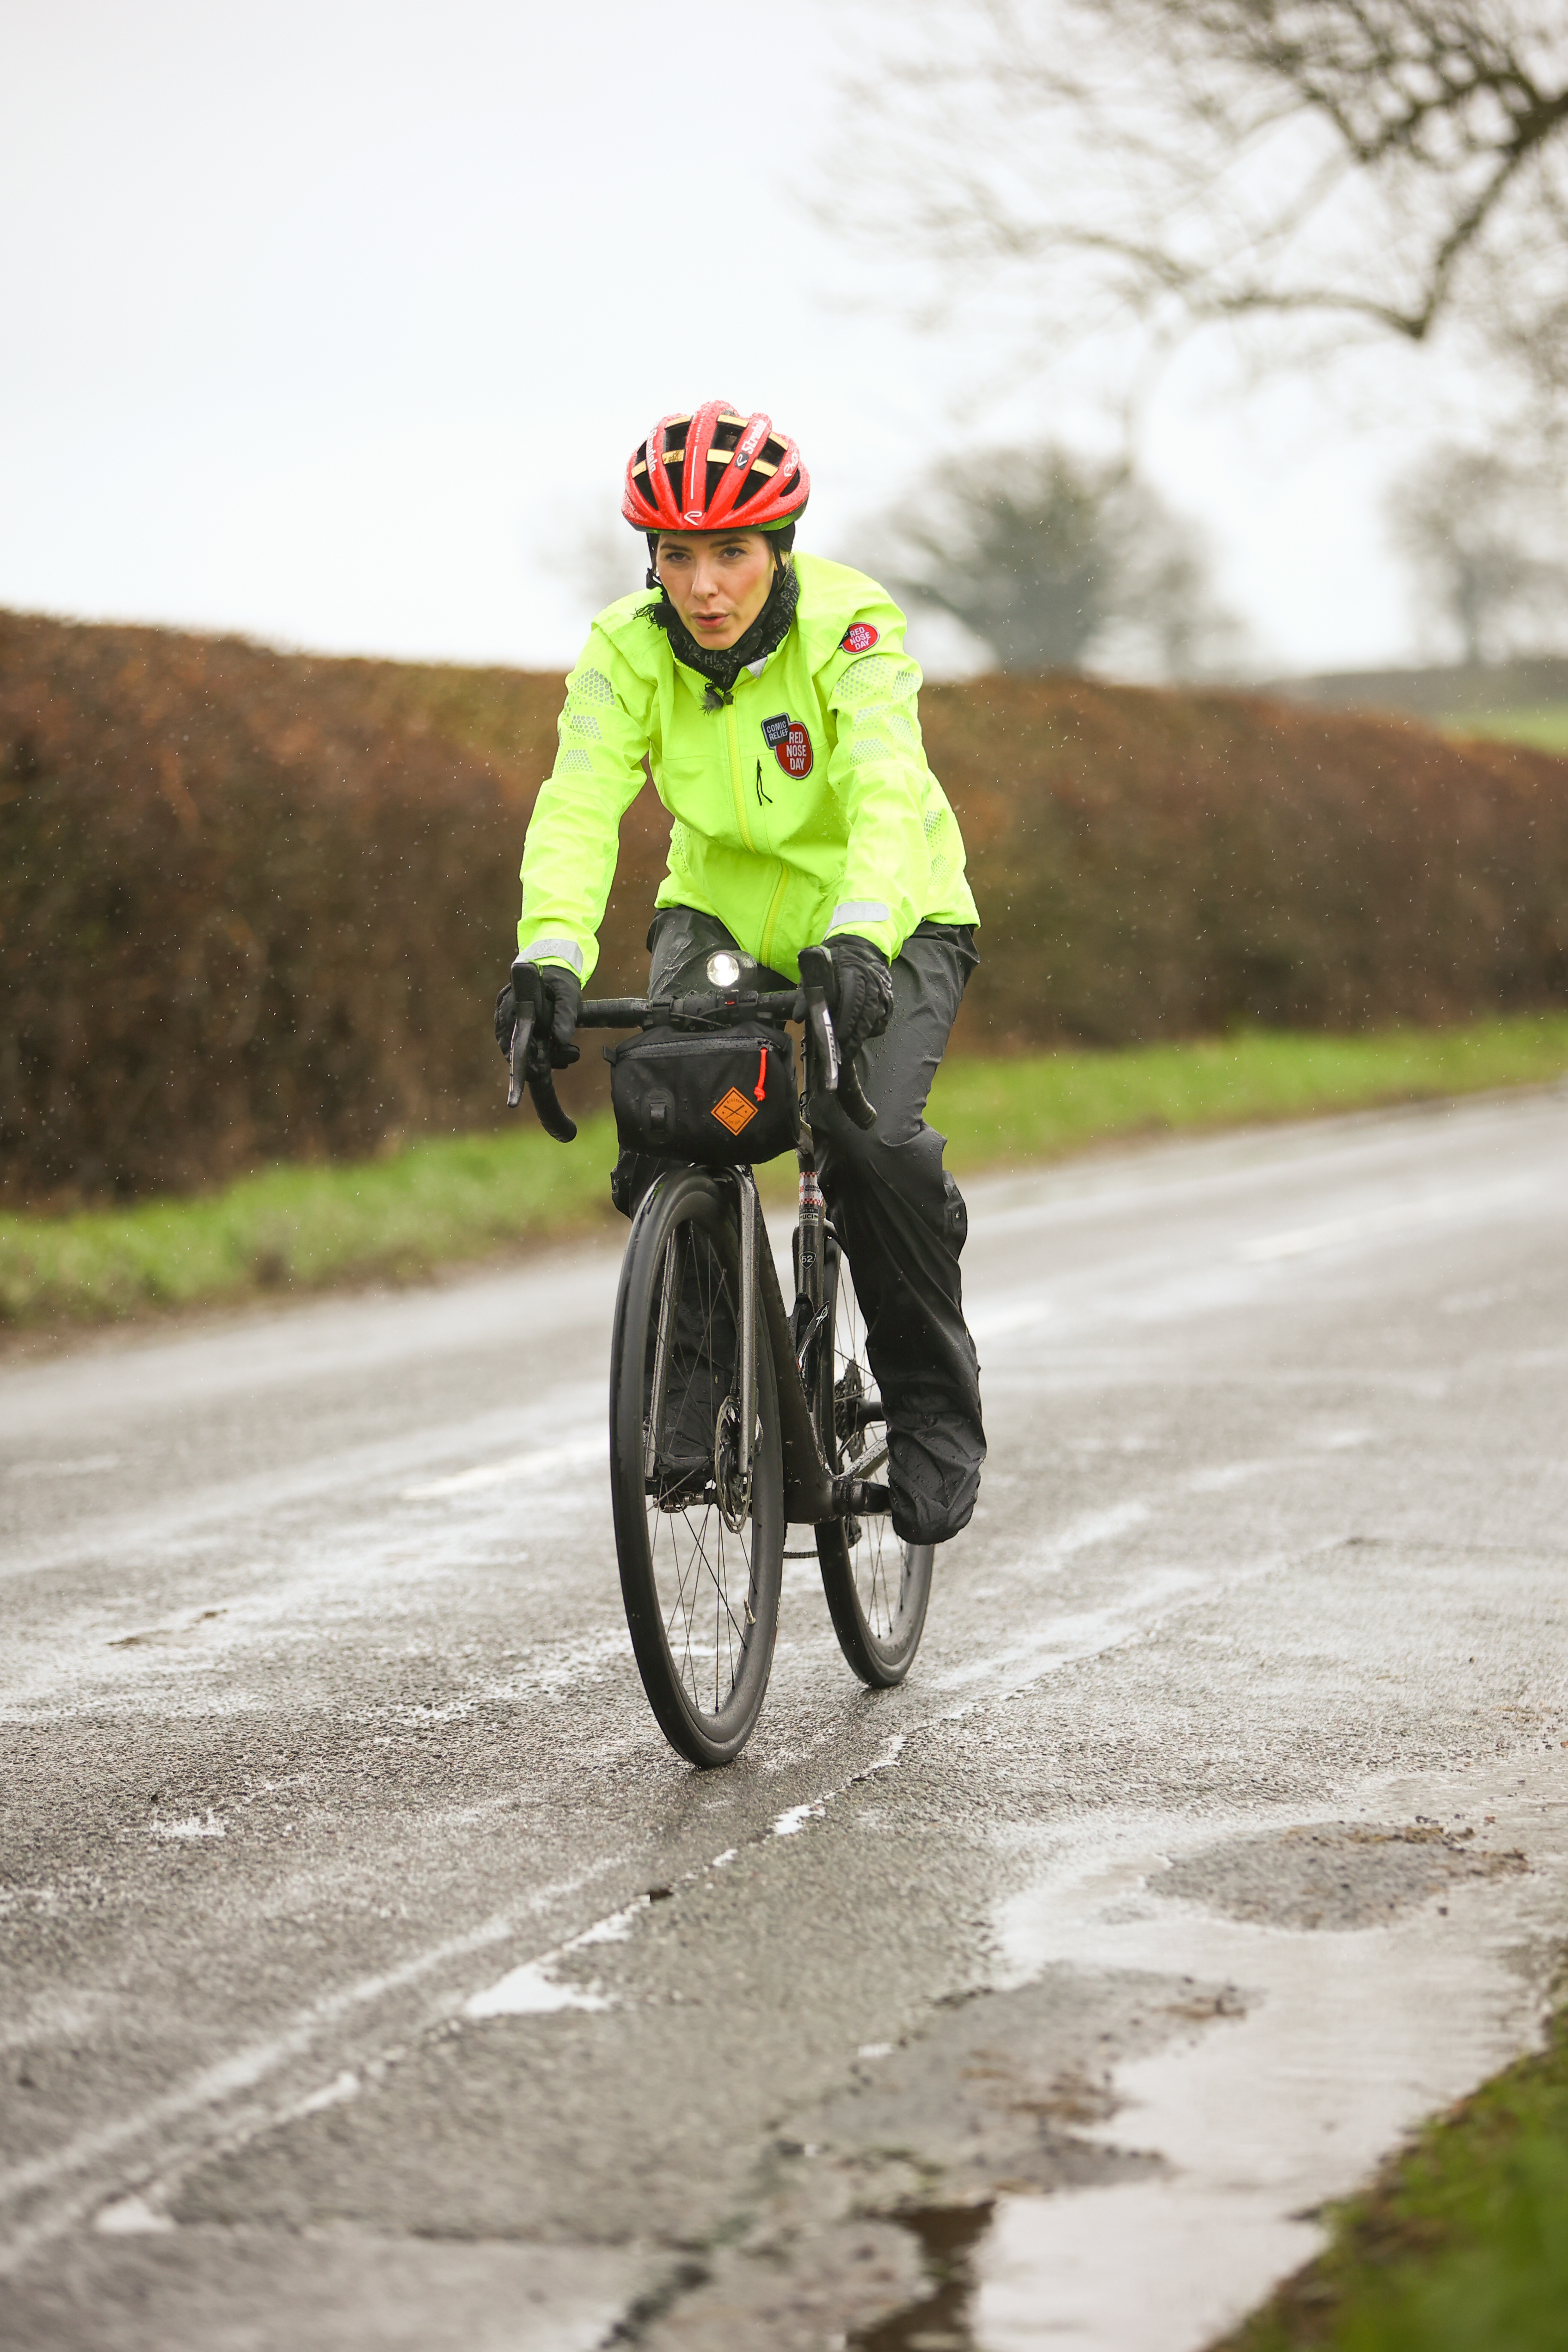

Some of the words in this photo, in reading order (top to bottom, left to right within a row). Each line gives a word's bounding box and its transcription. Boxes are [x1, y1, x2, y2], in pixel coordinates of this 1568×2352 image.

[741, 419, 767, 455] Stradale
[646, 429, 658, 475] Stradale
[849, 626, 865, 637] RED
[849, 632, 871, 646] NOSE
[854, 638, 870, 650] DAY
[766, 721, 787, 734] COMIC
[769, 728, 788, 741] RELIEF
[789, 732, 804, 744] RED
[786, 744, 807, 757] NOSE
[790, 758, 805, 770] DAY
[801, 1255, 813, 1263] 52
